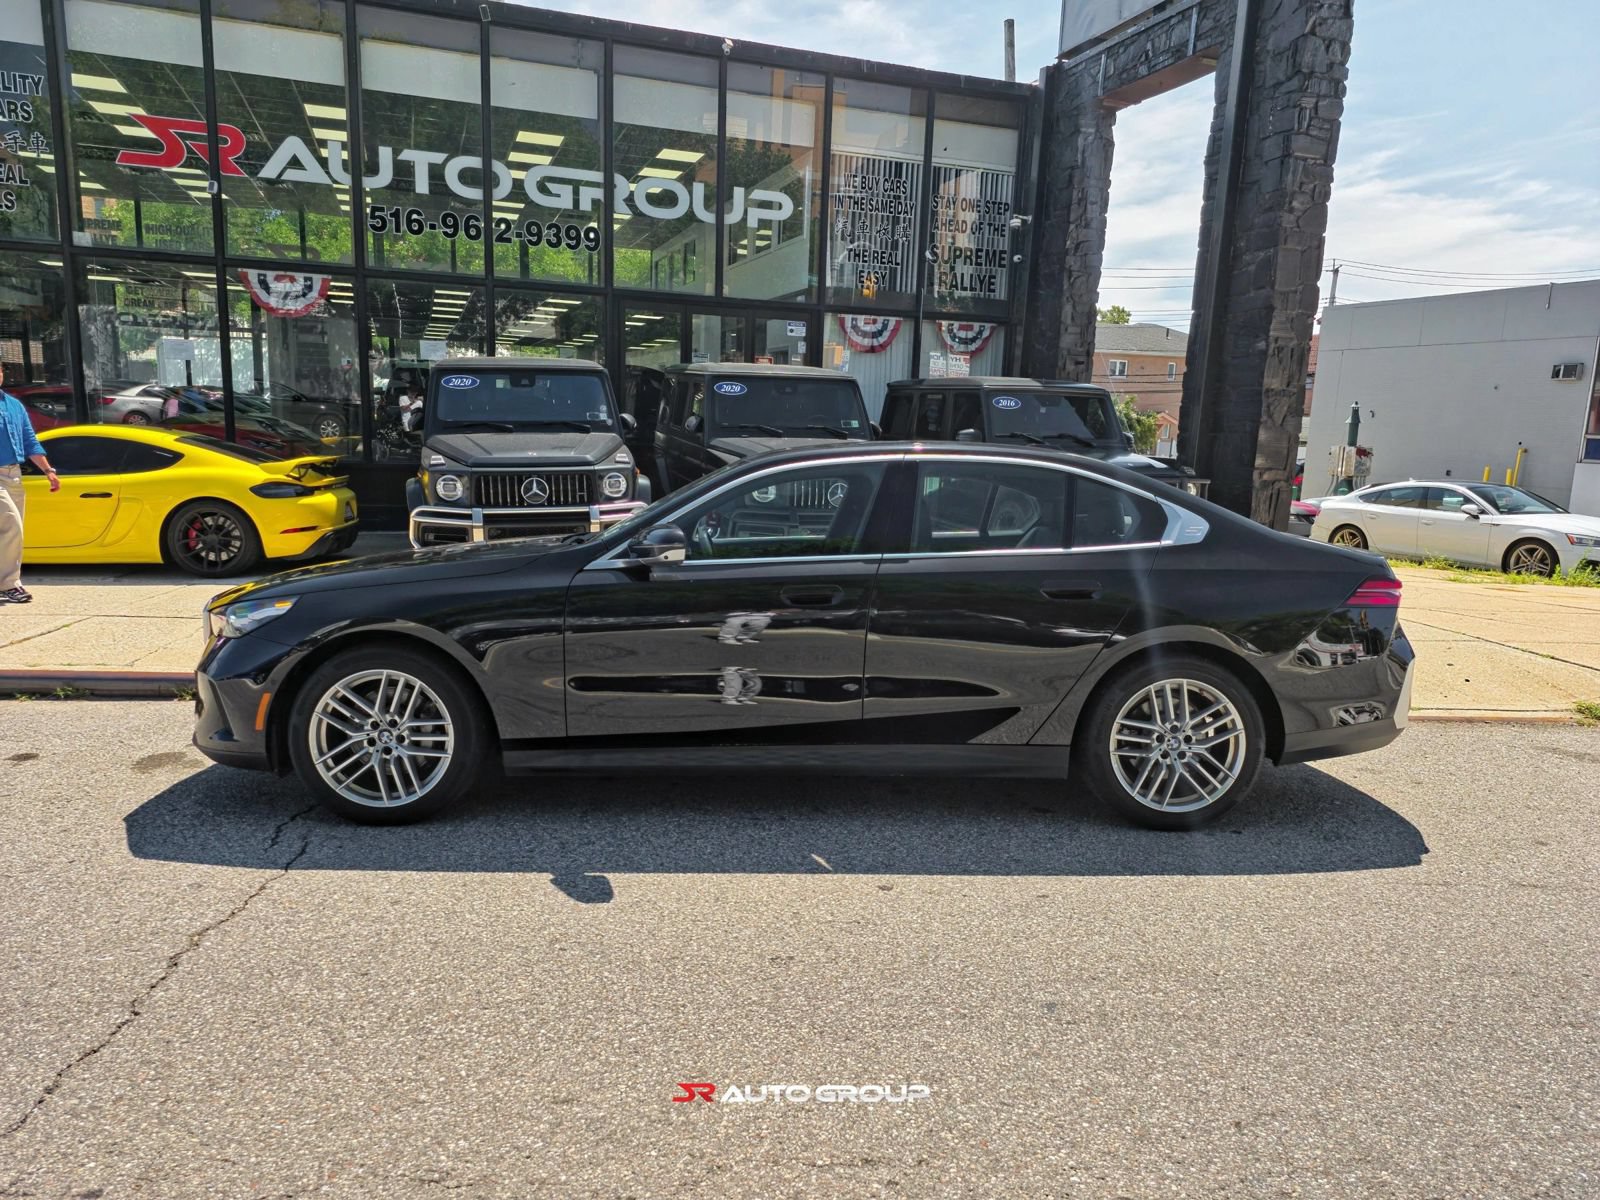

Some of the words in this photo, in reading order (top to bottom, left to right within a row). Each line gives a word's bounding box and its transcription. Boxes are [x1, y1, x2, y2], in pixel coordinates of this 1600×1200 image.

[0, 130, 50, 158] 手車
[257, 135, 513, 201] AUTO
[524, 165, 794, 228] GROUP
[844, 173, 858, 190] WE
[860, 175, 880, 193] BUY
[882, 178, 908, 195] CARS
[0, 190, 17, 212] S
[834, 193, 844, 210] IN
[847, 194, 866, 212] THE
[868, 197, 895, 215] SAME
[896, 201, 915, 217] DAY
[932, 194, 957, 211] STAY
[960, 197, 981, 214] ONE
[984, 199, 1010, 216] STEP
[932, 216, 968, 234] AHEAD
[970, 221, 984, 236] OF
[986, 221, 1007, 238] THE
[847, 247, 868, 264] THE
[871, 248, 900, 267] REAL
[929, 243, 1008, 269] SUPREME
[858, 269, 888, 287] EASY
[938, 271, 998, 294] RALLYE
[448, 377, 472, 386] 2020
[720, 384, 741, 393] 2020
[998, 399, 1016, 407] 2016
